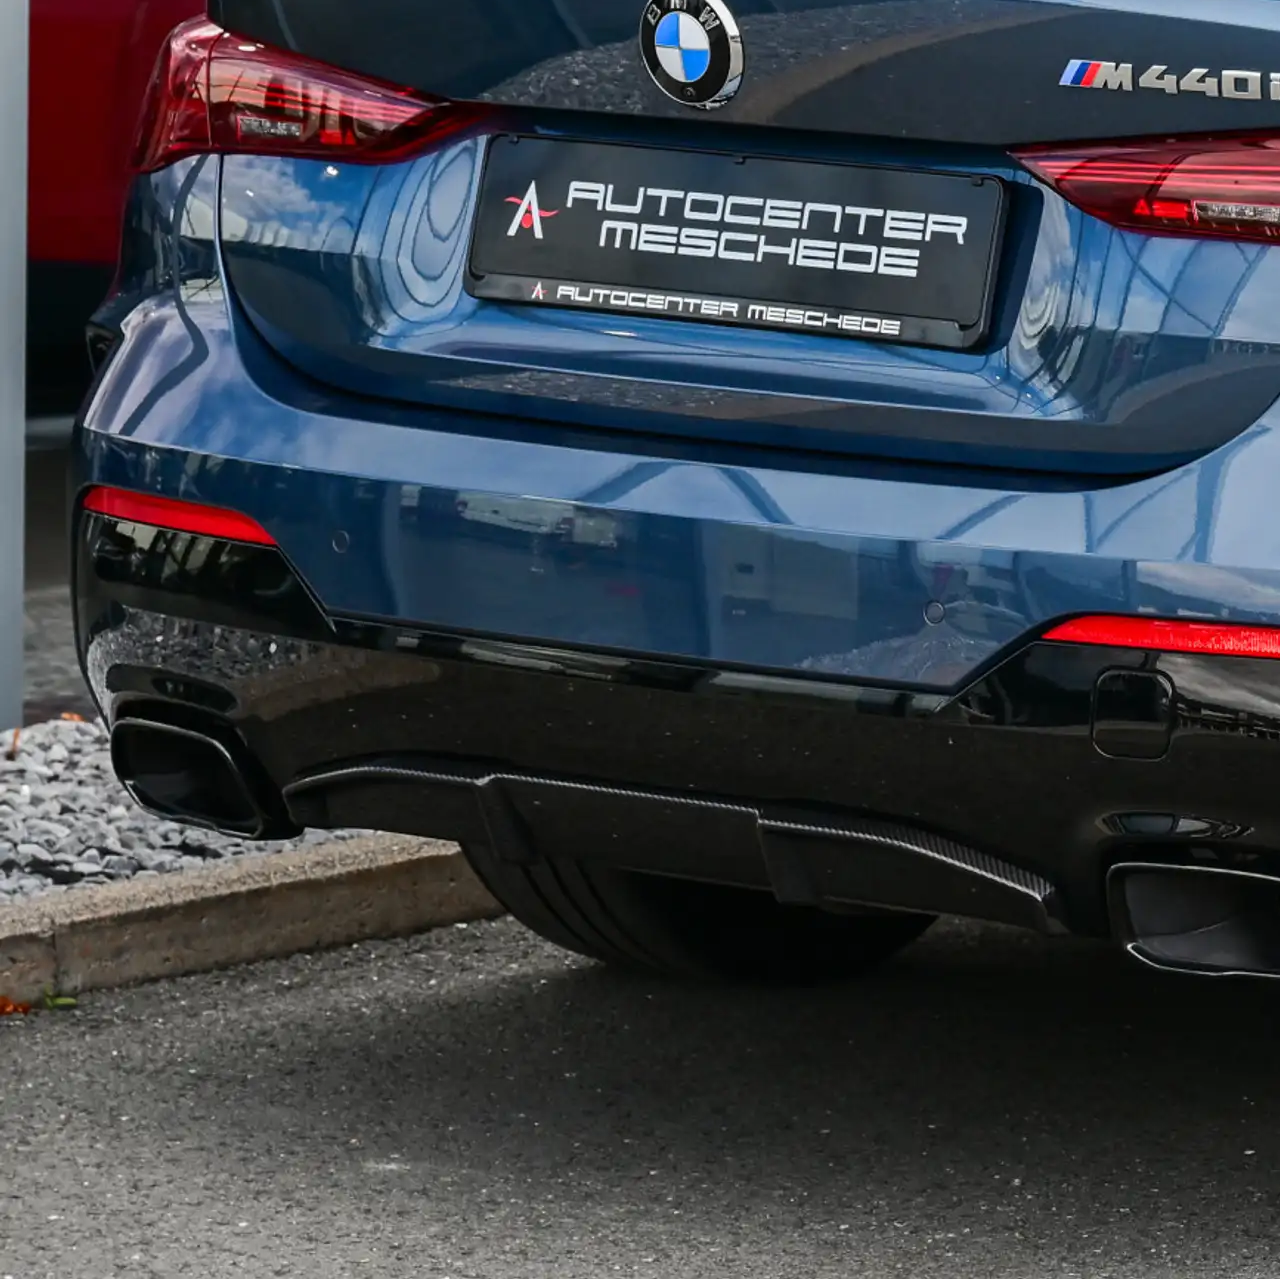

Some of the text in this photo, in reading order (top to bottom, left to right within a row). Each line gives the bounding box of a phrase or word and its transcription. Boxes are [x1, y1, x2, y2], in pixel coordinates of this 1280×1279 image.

[566, 181, 968, 245] AUTOCENTER
[599, 220, 920, 277] MESCHEDE
[556, 285, 739, 317] AUTOCENTER
[747, 304, 901, 336] MESCHEDE
